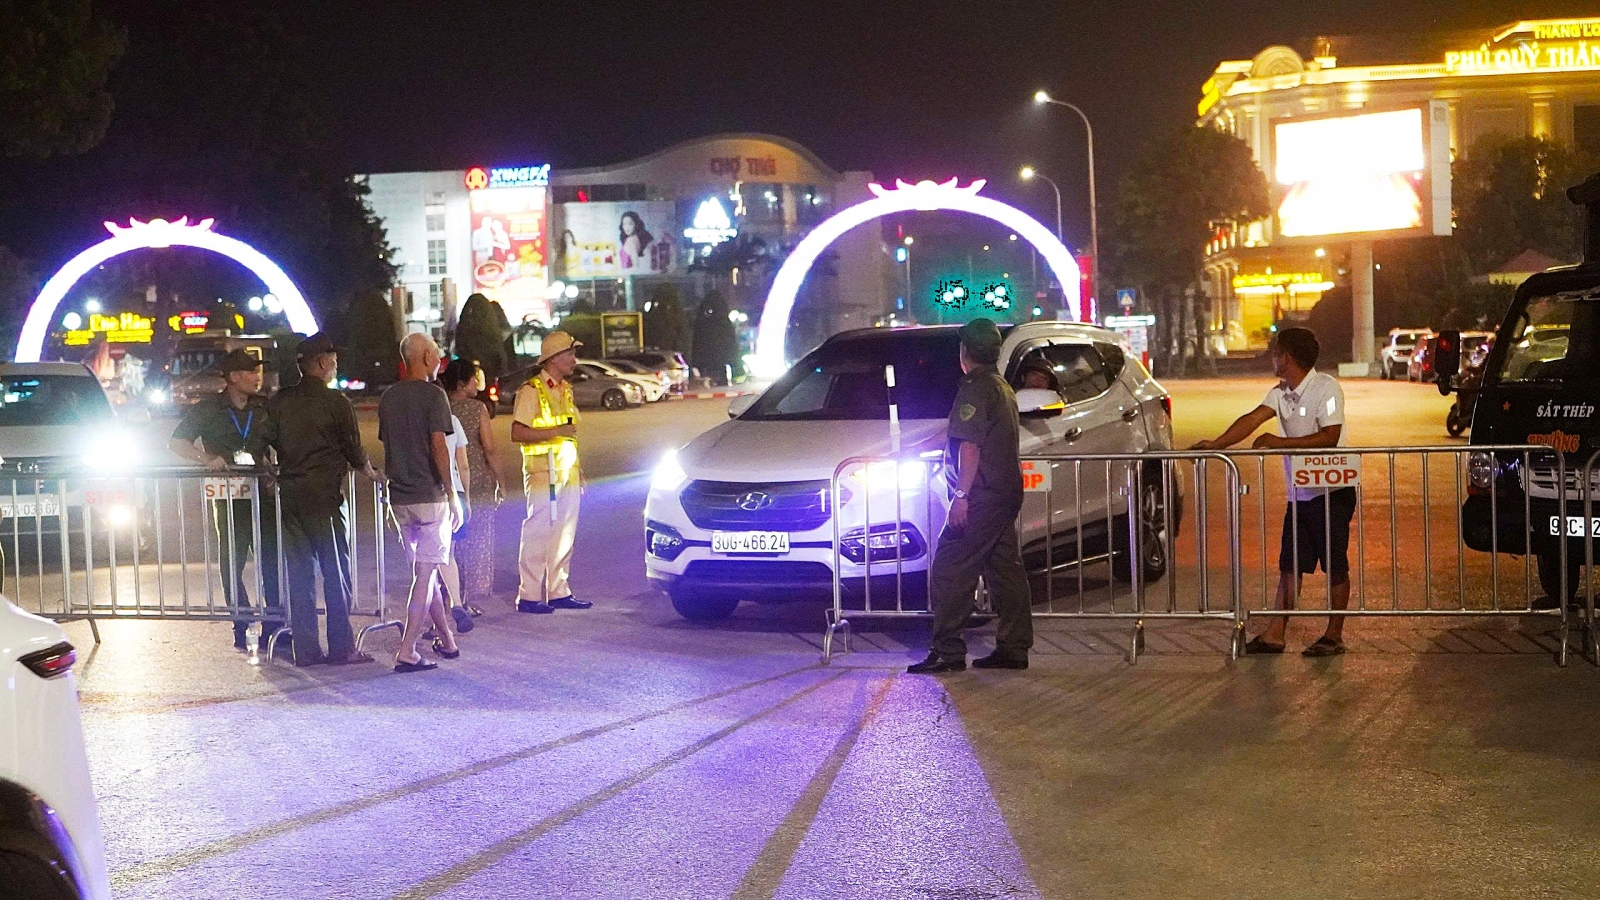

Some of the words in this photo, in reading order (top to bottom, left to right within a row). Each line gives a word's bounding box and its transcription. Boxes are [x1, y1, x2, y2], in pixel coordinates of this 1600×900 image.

[1445, 43, 1490, 71] PHÚ
[1494, 41, 1541, 69] QUÝ
[1536, 399, 1561, 417] SẮT
[1563, 402, 1595, 417] THÉP
[1304, 457, 1348, 466] POLICE
[1295, 469, 1358, 485] STOP
[205, 484, 251, 498] STOP
[714, 534, 786, 550] 30G-466.24
